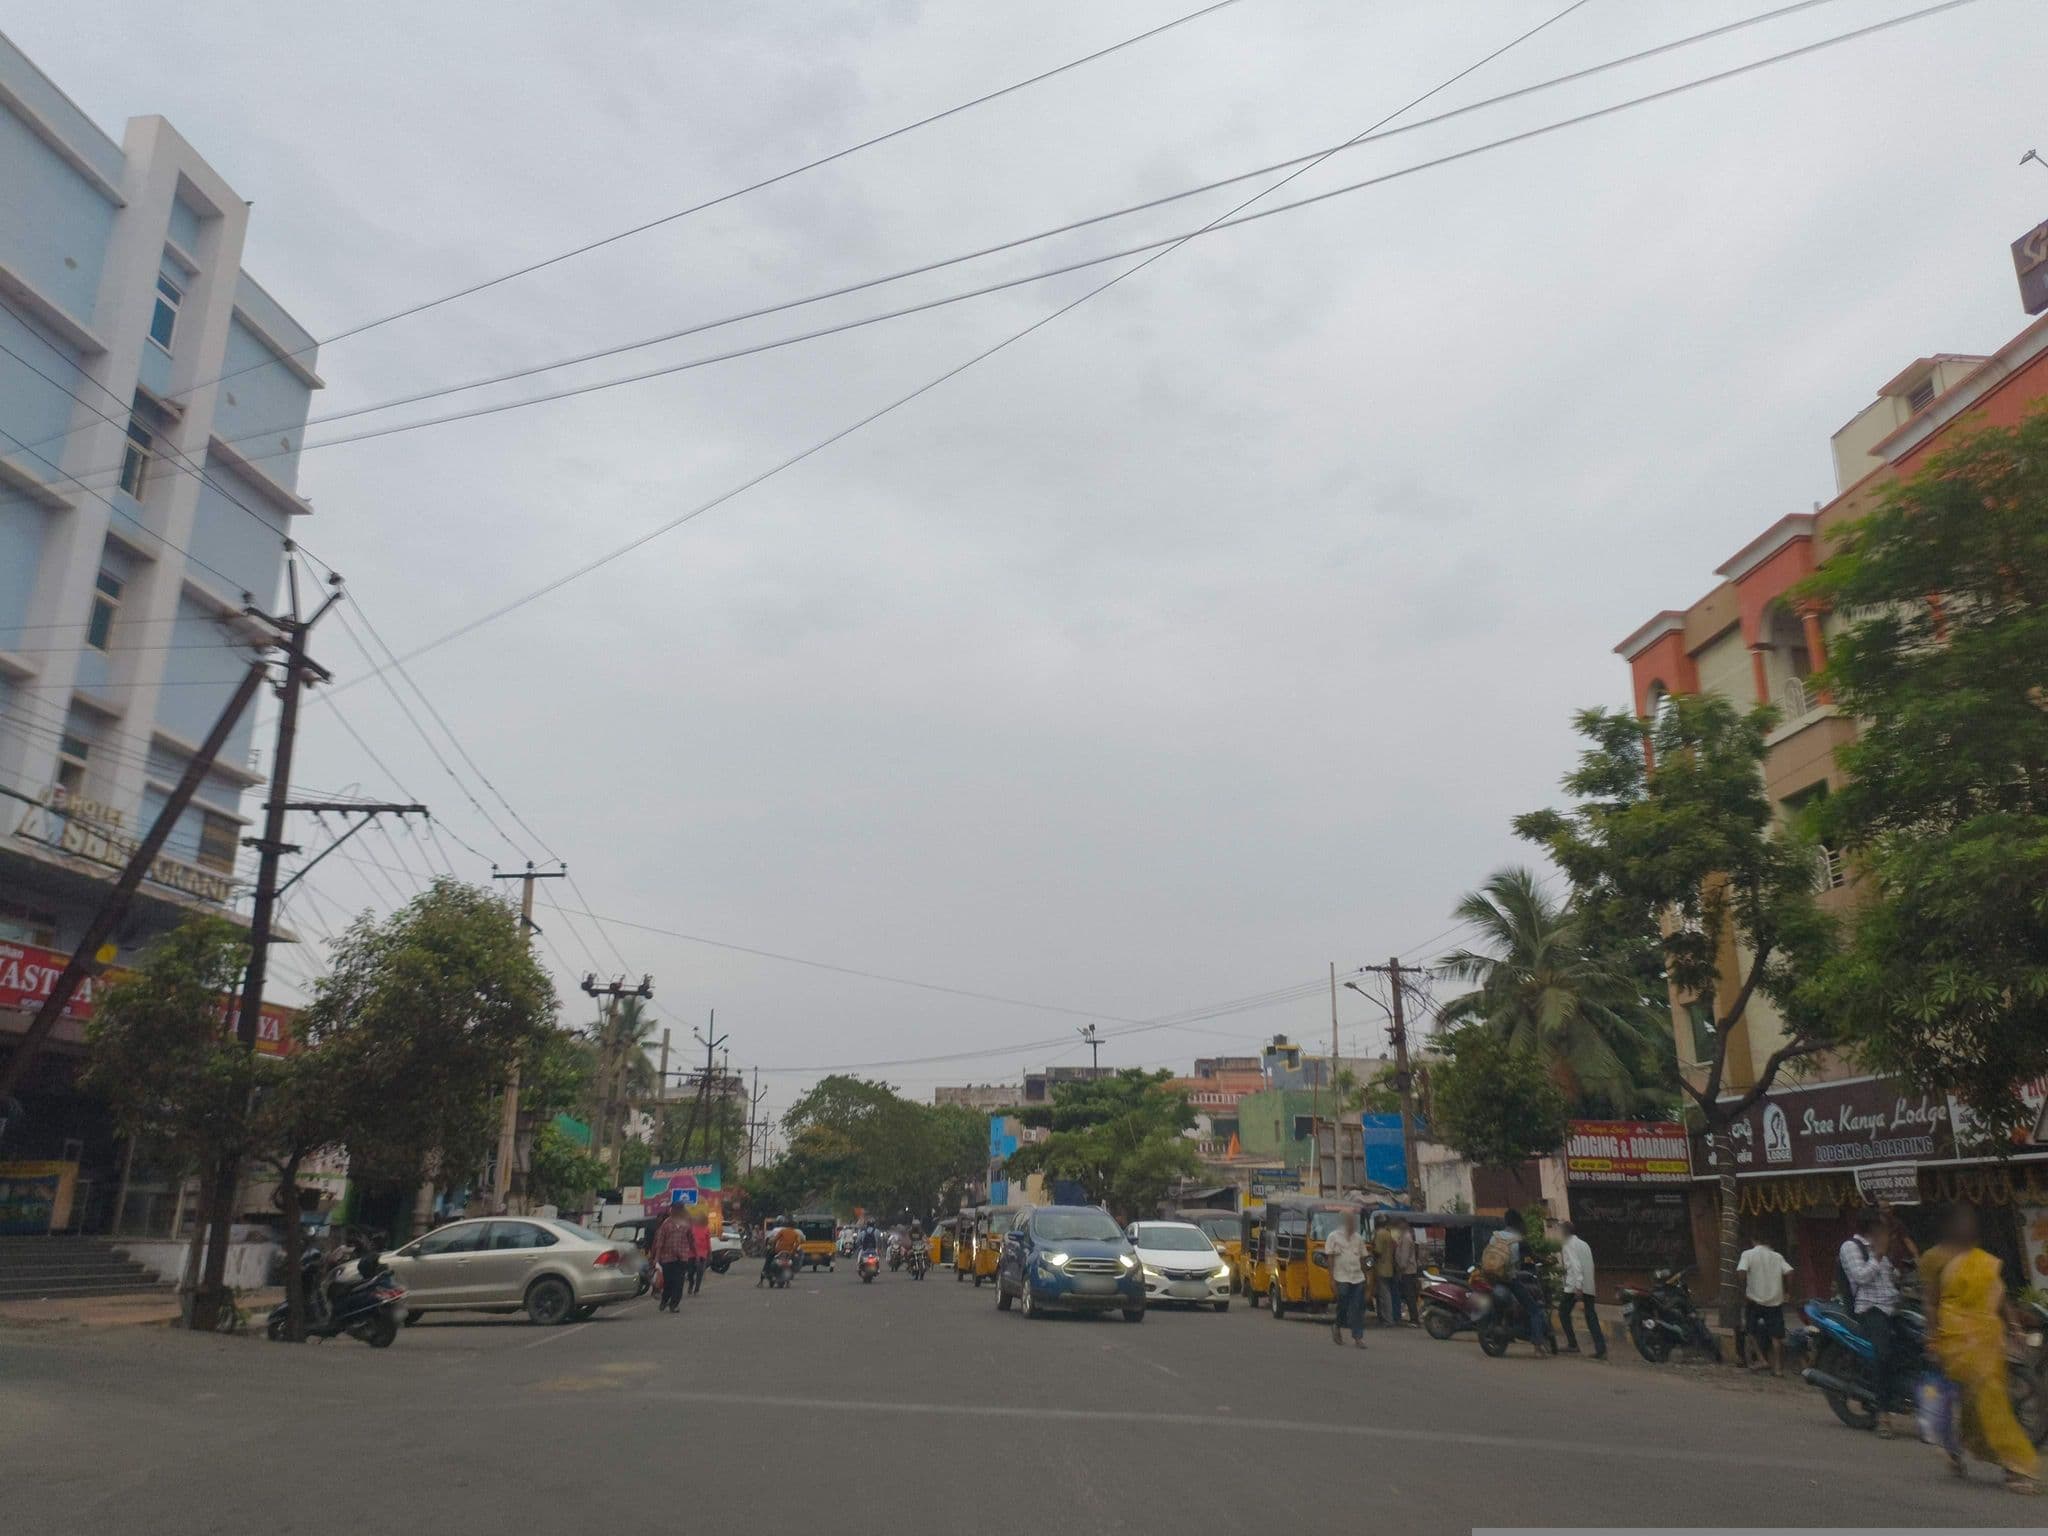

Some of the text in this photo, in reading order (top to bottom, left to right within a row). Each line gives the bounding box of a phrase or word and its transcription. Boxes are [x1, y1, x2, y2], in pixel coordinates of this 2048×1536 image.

[1800, 1107, 1835, 1136] Sree
[1836, 1103, 1886, 1140] Kanya
[1890, 1094, 1947, 1135] Lodge
[1567, 1135, 1619, 1158] LODGING
[1620, 1139, 1630, 1158] &
[1630, 1137, 1687, 1159] BOARDING
[1816, 1136, 1935, 1163] LODGING & BOARDING
